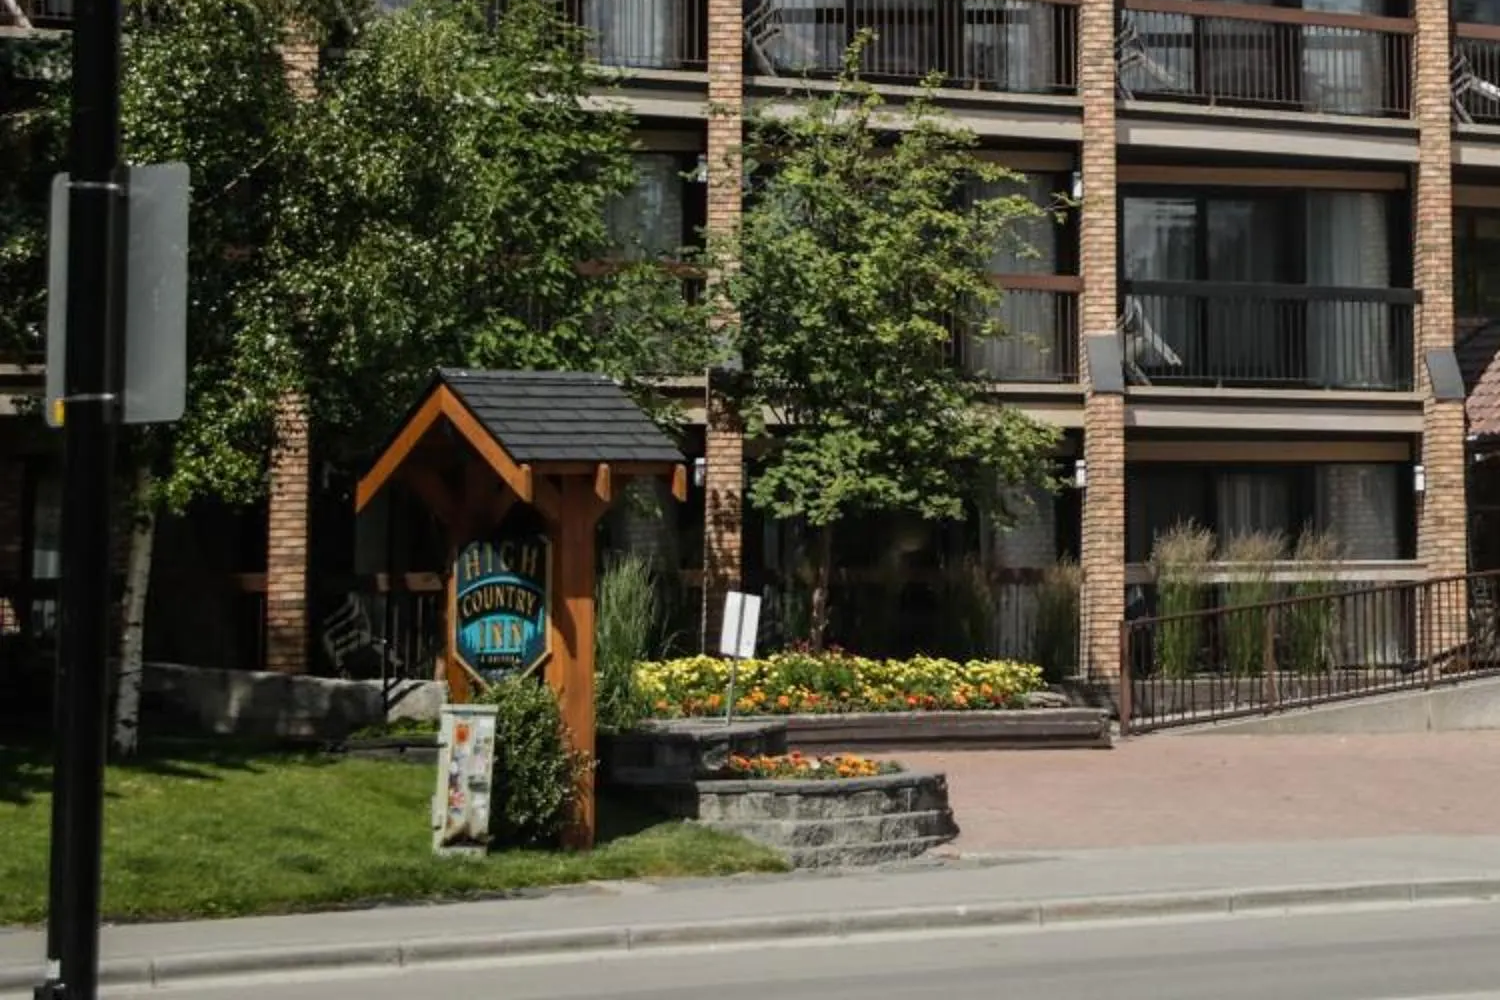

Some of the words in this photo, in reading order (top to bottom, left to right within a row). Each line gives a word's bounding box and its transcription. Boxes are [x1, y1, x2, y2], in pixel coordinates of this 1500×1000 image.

[463, 541, 538, 580] HIGH
[462, 584, 537, 617] COUNTRY
[479, 621, 521, 648] INN
